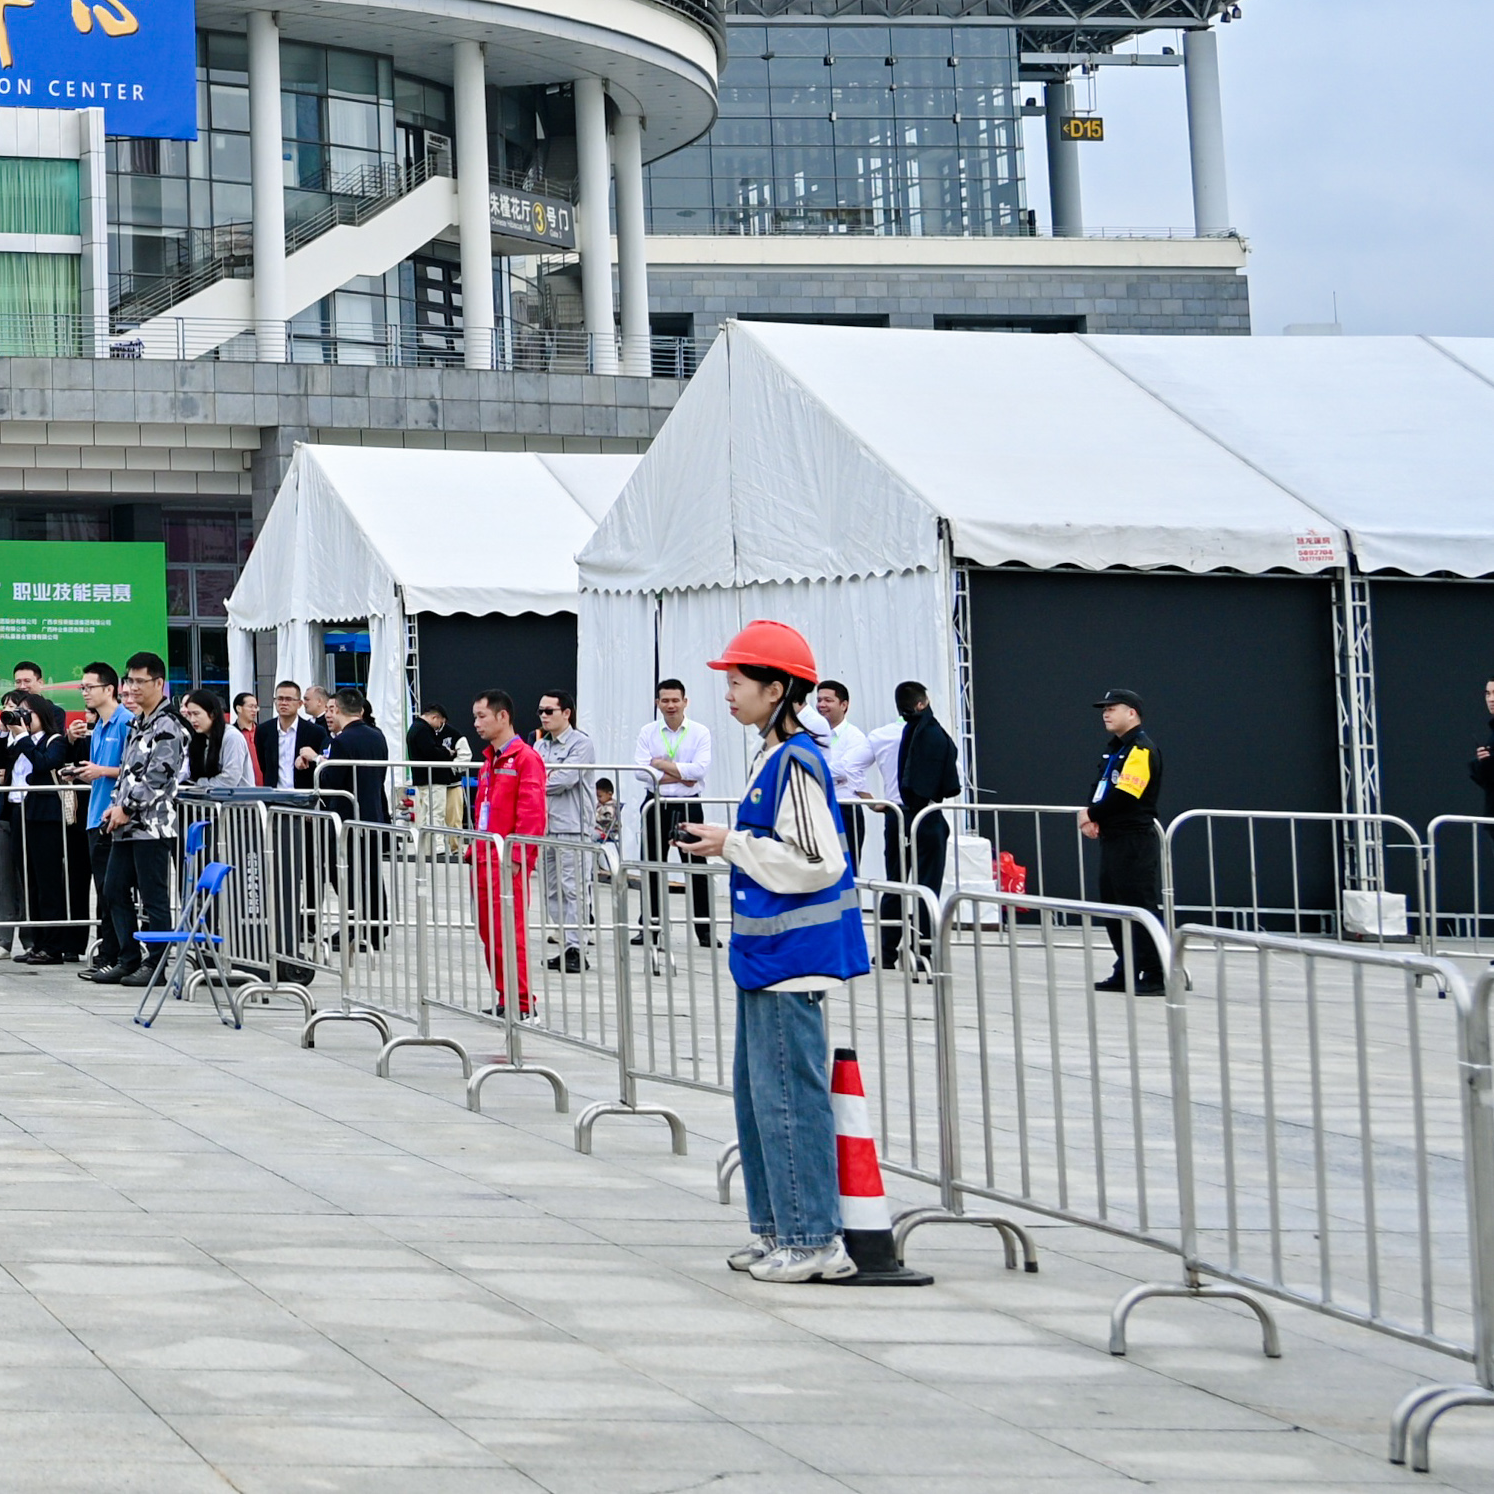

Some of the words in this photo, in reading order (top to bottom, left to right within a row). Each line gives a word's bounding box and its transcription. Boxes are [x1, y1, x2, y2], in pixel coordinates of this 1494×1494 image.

[48, 79, 144, 102] CENTER
[1070, 120, 1102, 138] D15
[490, 192, 531, 222] 朱槿花厅
[546, 205, 569, 231] 号门
[12, 582, 133, 603] 职业技能竞赛
